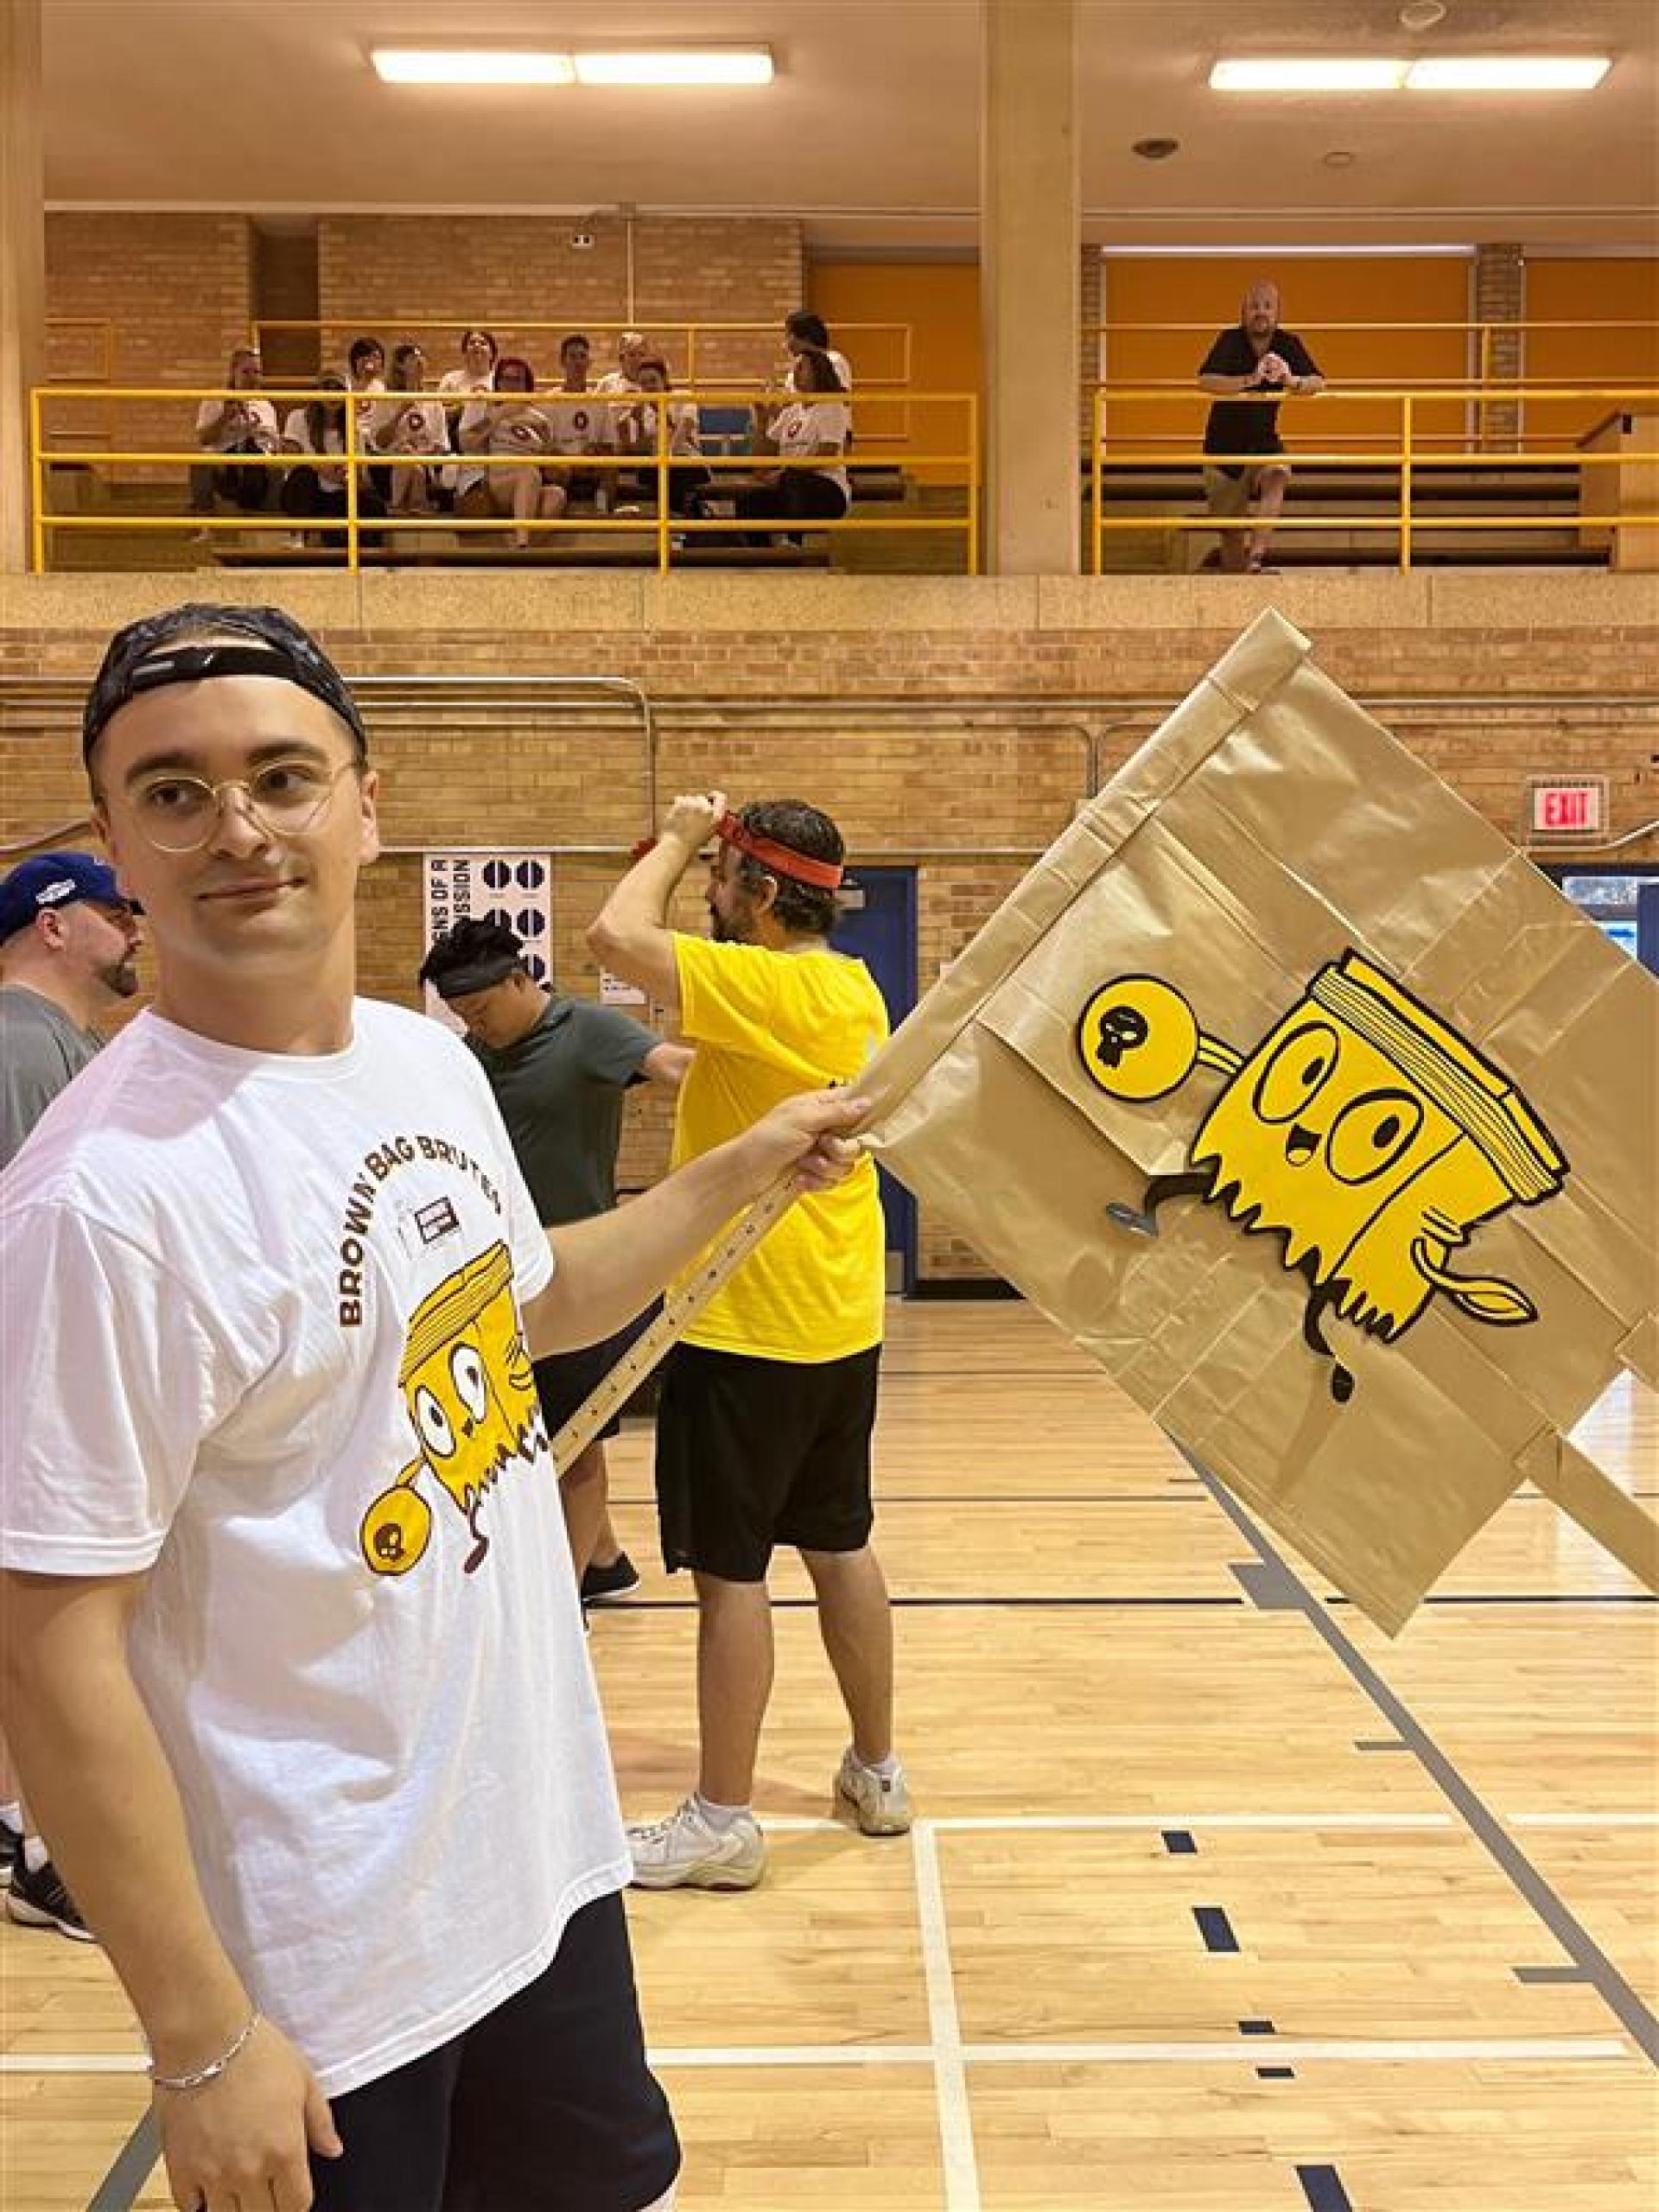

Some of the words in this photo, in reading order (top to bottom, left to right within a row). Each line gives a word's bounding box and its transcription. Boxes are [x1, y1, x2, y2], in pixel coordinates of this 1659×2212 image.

[1543, 790, 1588, 824] EXIT
[430, 859, 448, 872] A
[430, 878, 448, 899] OF
[339, 1172, 377, 1328] BROWN
[364, 1135, 414, 1181] BAG
